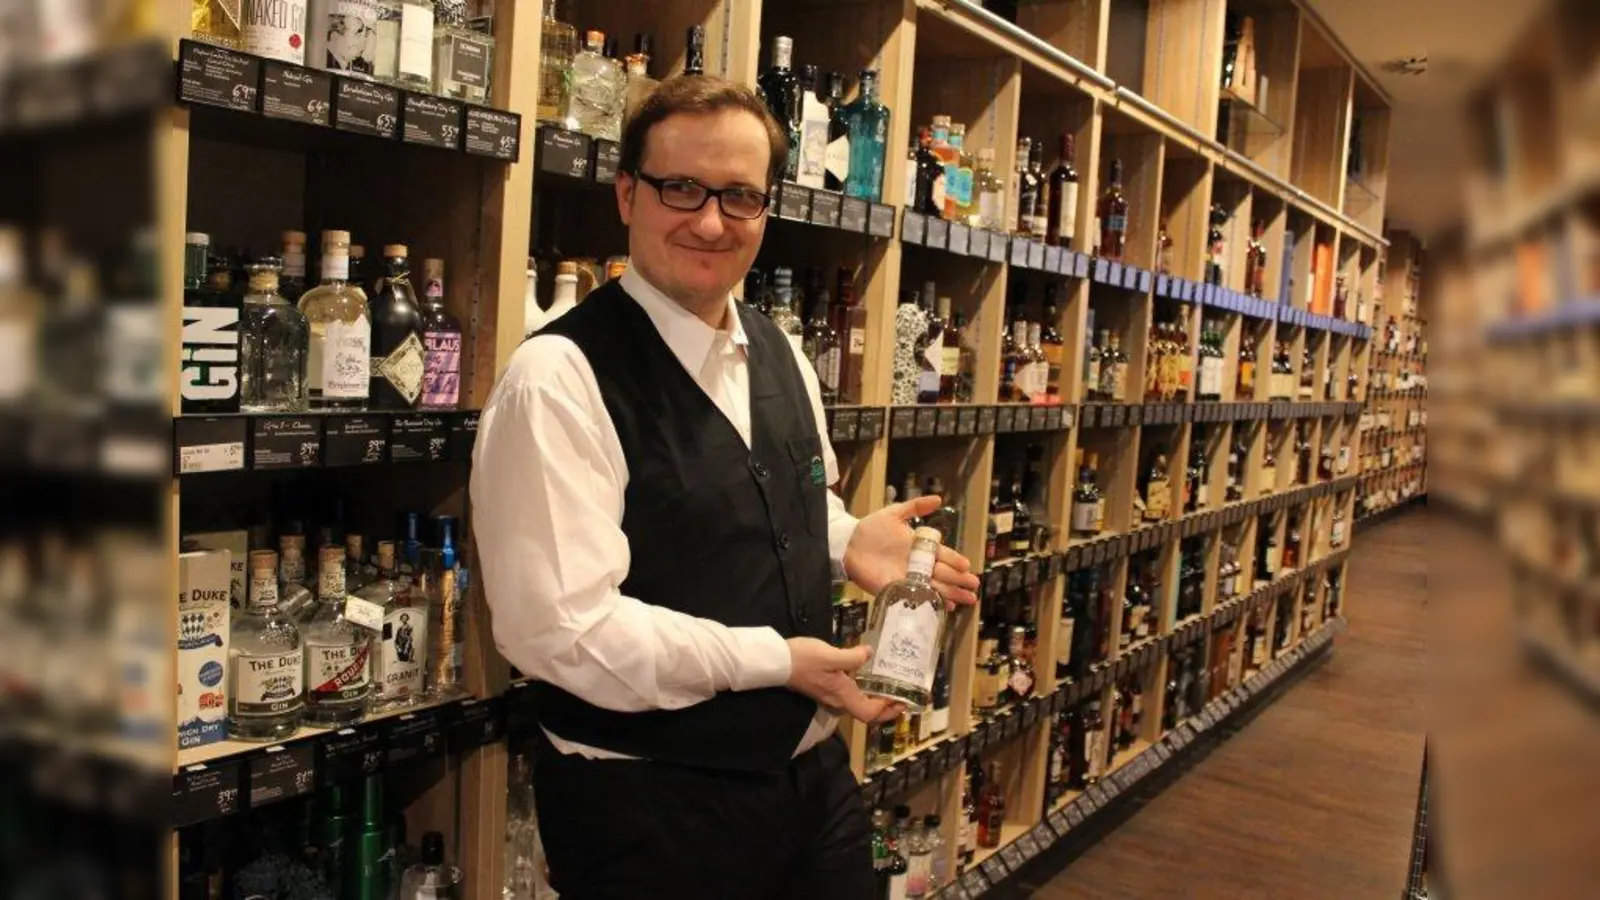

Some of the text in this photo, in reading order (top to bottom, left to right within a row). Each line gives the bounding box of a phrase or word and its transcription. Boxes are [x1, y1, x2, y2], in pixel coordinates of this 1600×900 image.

[181, 306, 239, 400] GIN
[231, 561, 243, 572] KE
[192, 589, 227, 601] DUKE
[322, 650, 346, 661] THE
[249, 660, 273, 672] THE
[342, 690, 358, 699] GIN
[271, 702, 288, 711] GIN
[182, 736, 201, 746] GIN
